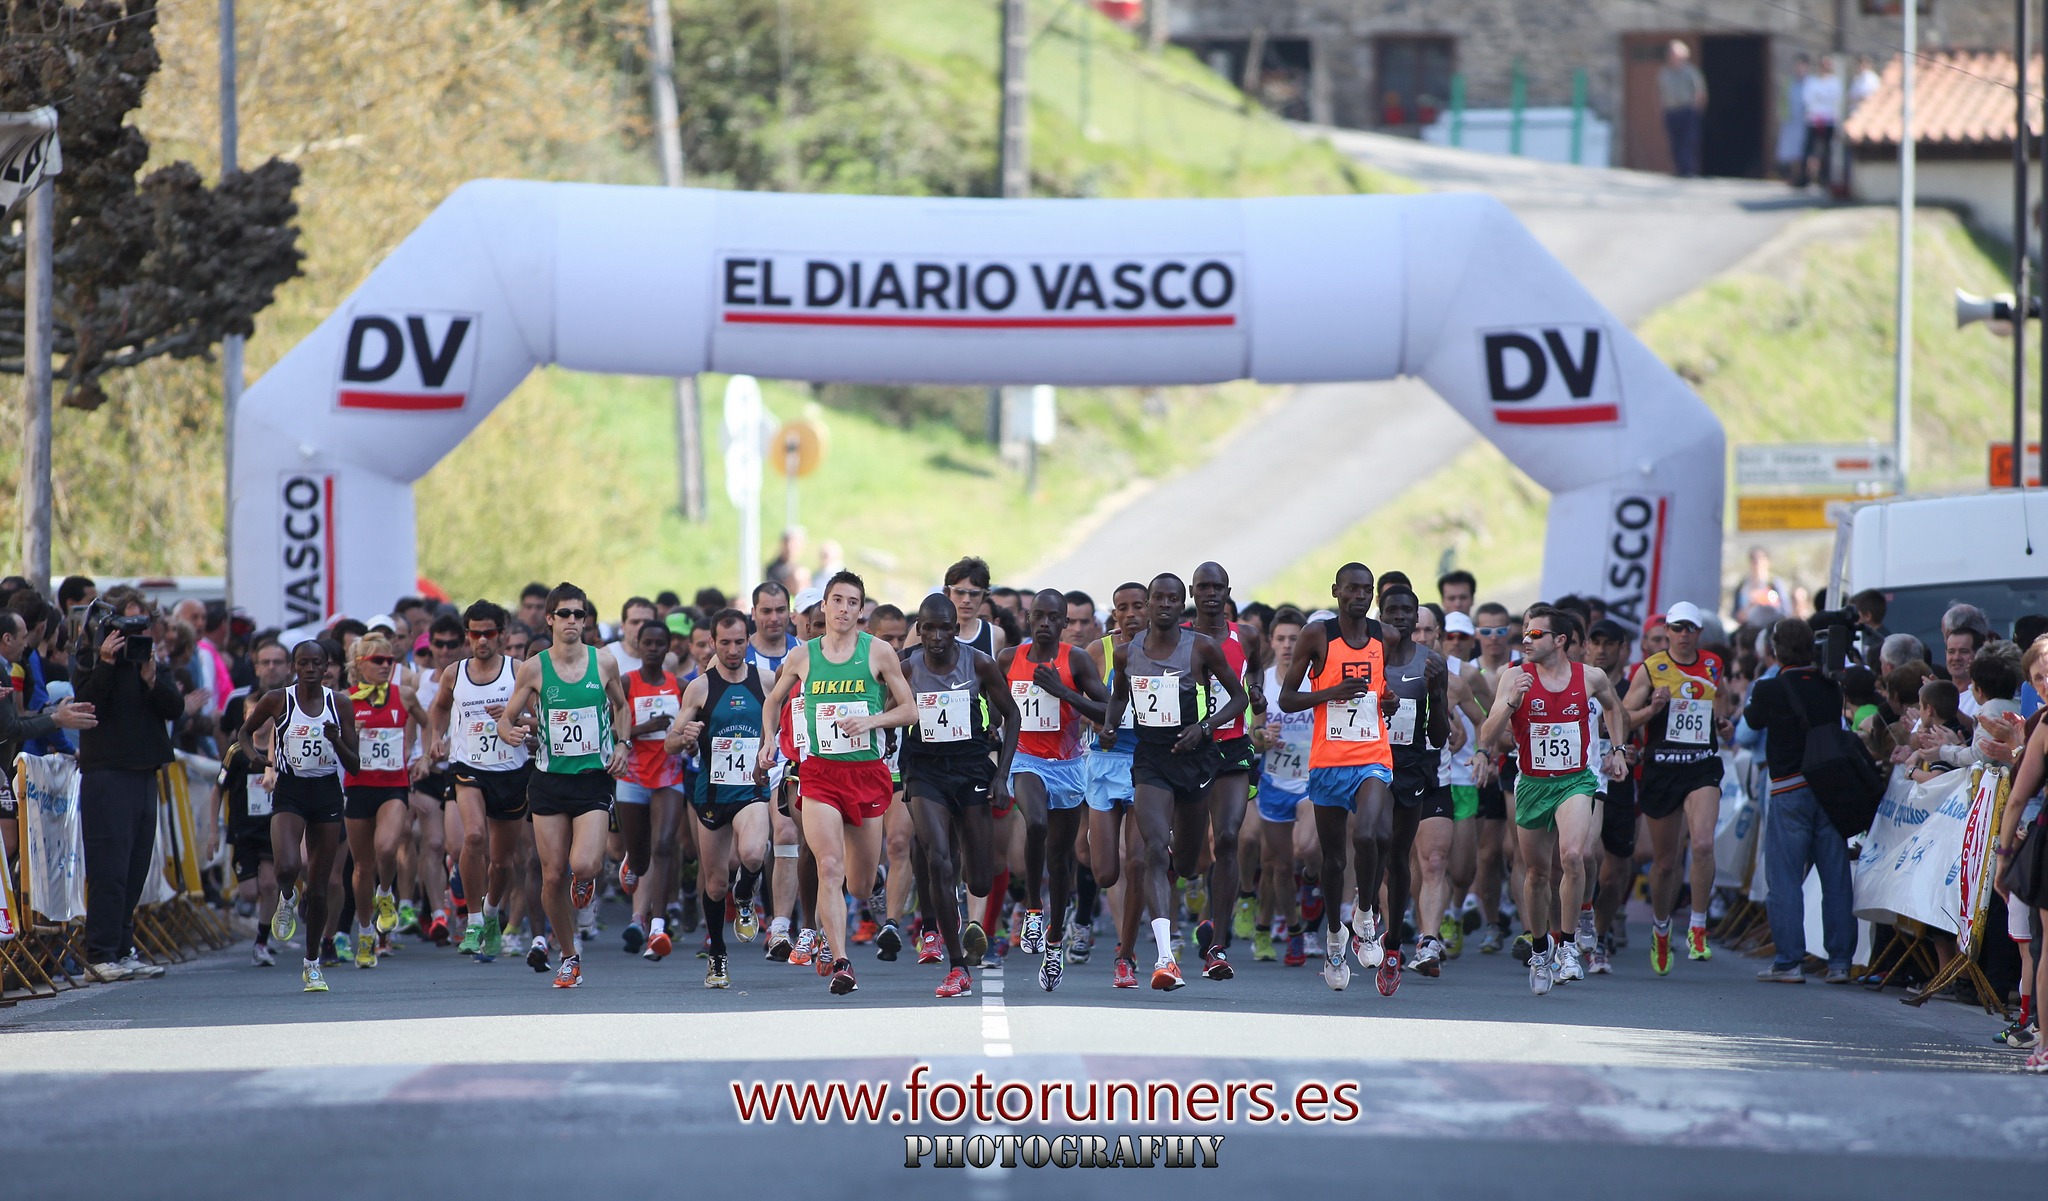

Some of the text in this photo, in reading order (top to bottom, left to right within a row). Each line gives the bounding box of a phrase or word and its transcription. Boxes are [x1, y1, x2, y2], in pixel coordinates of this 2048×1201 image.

[725, 259, 1235, 311] EL DIARIO VASCO
[343, 315, 471, 388] DV
[1485, 328, 1601, 401] DV
[284, 476, 321, 629] VASCO
[1604, 497, 1654, 637] ASCO
[811, 680, 866, 695] BIKILA
[1023, 698, 1039, 717] 11
[1148, 694, 1157, 712] 2
[937, 709, 948, 727] 4
[1347, 709, 1357, 727] 7
[1676, 714, 1703, 731] 865
[562, 725, 582, 742] 20
[1331, 727, 1342, 735] DV
[302, 740, 322, 757] 55
[372, 743, 390, 759] 56
[479, 735, 499, 752] 37
[821, 740, 832, 748] DV
[1539, 739, 1570, 757] 153
[725, 754, 745, 771] 14
[1274, 751, 1301, 768] 774
[714, 771, 725, 779] DV
